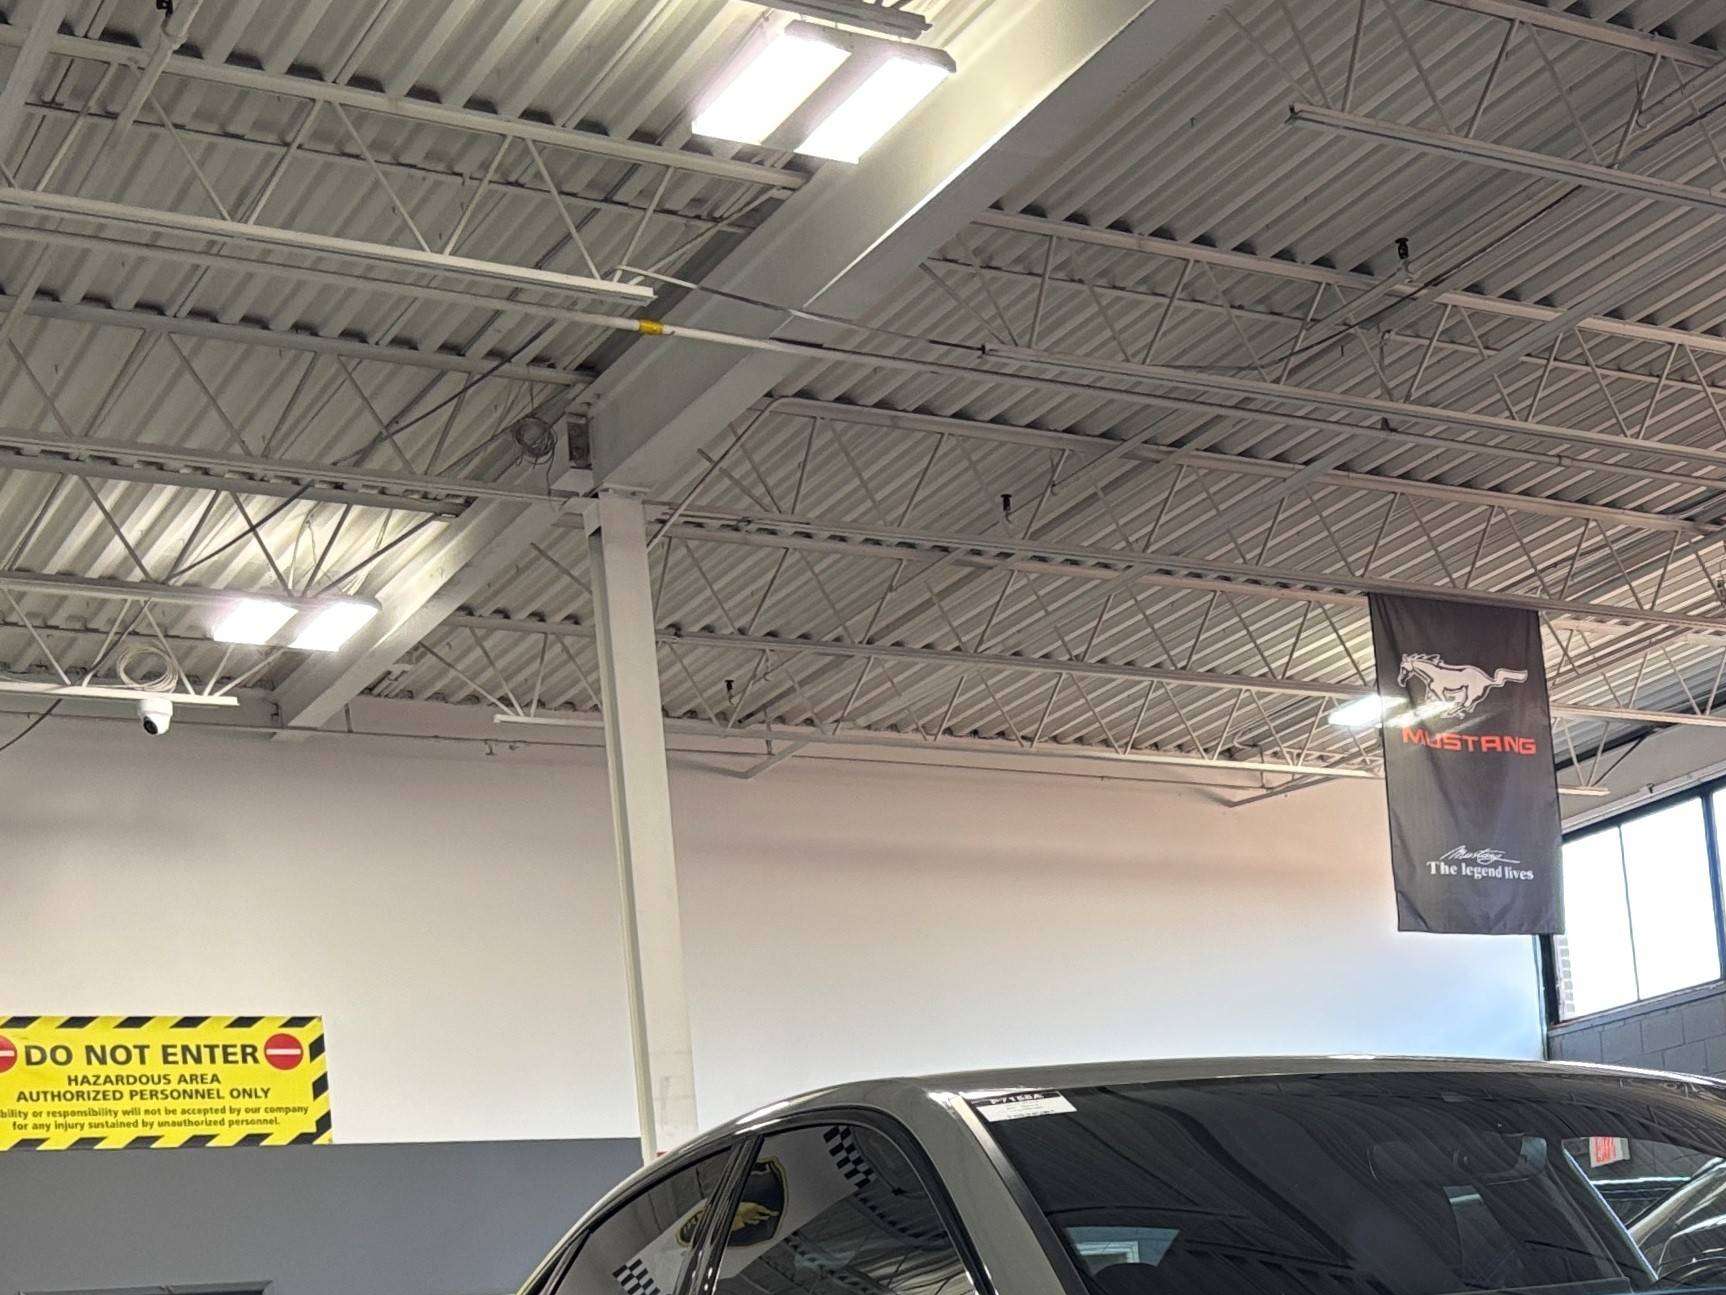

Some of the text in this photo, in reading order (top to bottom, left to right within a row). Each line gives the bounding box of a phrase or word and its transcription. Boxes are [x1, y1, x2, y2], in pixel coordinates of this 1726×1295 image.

[1401, 725, 1537, 756] MUSTANG
[1426, 861, 1534, 880] The legend lives
[24, 1043, 260, 1066] DO NOT ENTER
[67, 1073, 221, 1086] HAZARDOUS AREA
[16, 1087, 271, 1102] AUTHORIZED PERSONNEL ONLY
[32, 1110, 43, 1118] or
[47, 1107, 119, 1119] responsibility
[122, 1107, 141, 1116] will
[144, 1107, 161, 1116] not
[165, 1107, 177, 1115] be
[180, 1105, 226, 1117] accepted
[229, 1105, 241, 1116] by
[264, 1105, 309, 1115] company
[12, 1121, 28, 1130] for
[32, 1122, 51, 1132] any
[54, 1120, 85, 1131] injury
[88, 1119, 139, 1129] sustained
[141, 1119, 155, 1130] by
[157, 1117, 225, 1128] unauthorized
